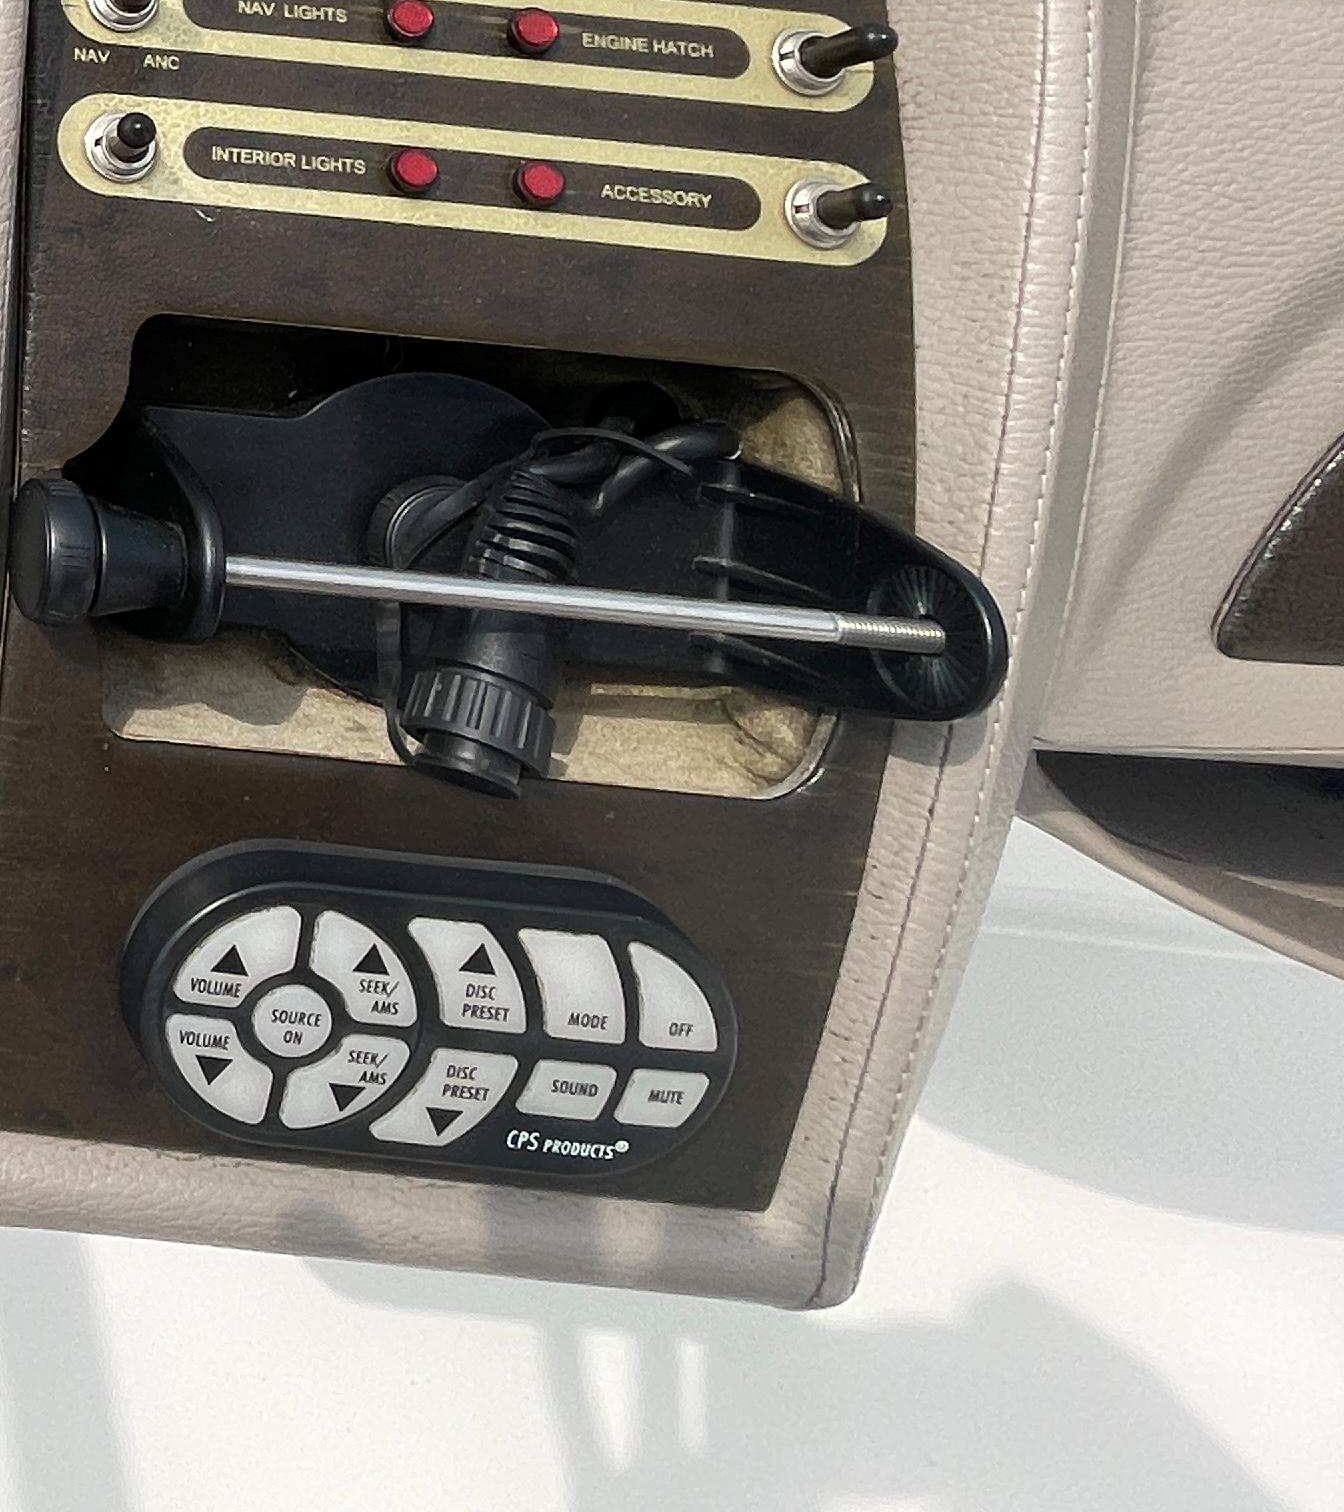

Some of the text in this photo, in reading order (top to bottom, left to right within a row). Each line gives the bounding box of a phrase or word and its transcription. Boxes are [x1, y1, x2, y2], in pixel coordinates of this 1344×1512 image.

[238, 0, 348, 23] NAV LIGHTS
[73, 45, 110, 64] NAV
[582, 31, 714, 59] ENGINE HATCH
[143, 53, 180, 70] ANC
[211, 145, 367, 175] INTERIOR LIGHTS
[600, 183, 713, 209] ACCESSORY
[189, 978, 242, 998] VOLUME
[358, 979, 400, 998] SEEK/
[465, 983, 496, 1001] DISC
[370, 1000, 399, 1015] AMS
[461, 1003, 510, 1022] PRESET
[270, 1008, 322, 1027] SOURCE
[567, 1011, 609, 1030] MODE
[282, 1029, 302, 1045] ON
[668, 1021, 694, 1038] OFF
[178, 1030, 230, 1050] VOLUME
[347, 1049, 389, 1067] SEEK/
[358, 1070, 388, 1085] AMS
[446, 1064, 479, 1080] DISC
[442, 1084, 490, 1101] PRESET
[551, 1078, 599, 1097] SOUND
[647, 1089, 686, 1105] MUTE
[506, 1129, 539, 1152] CPS
